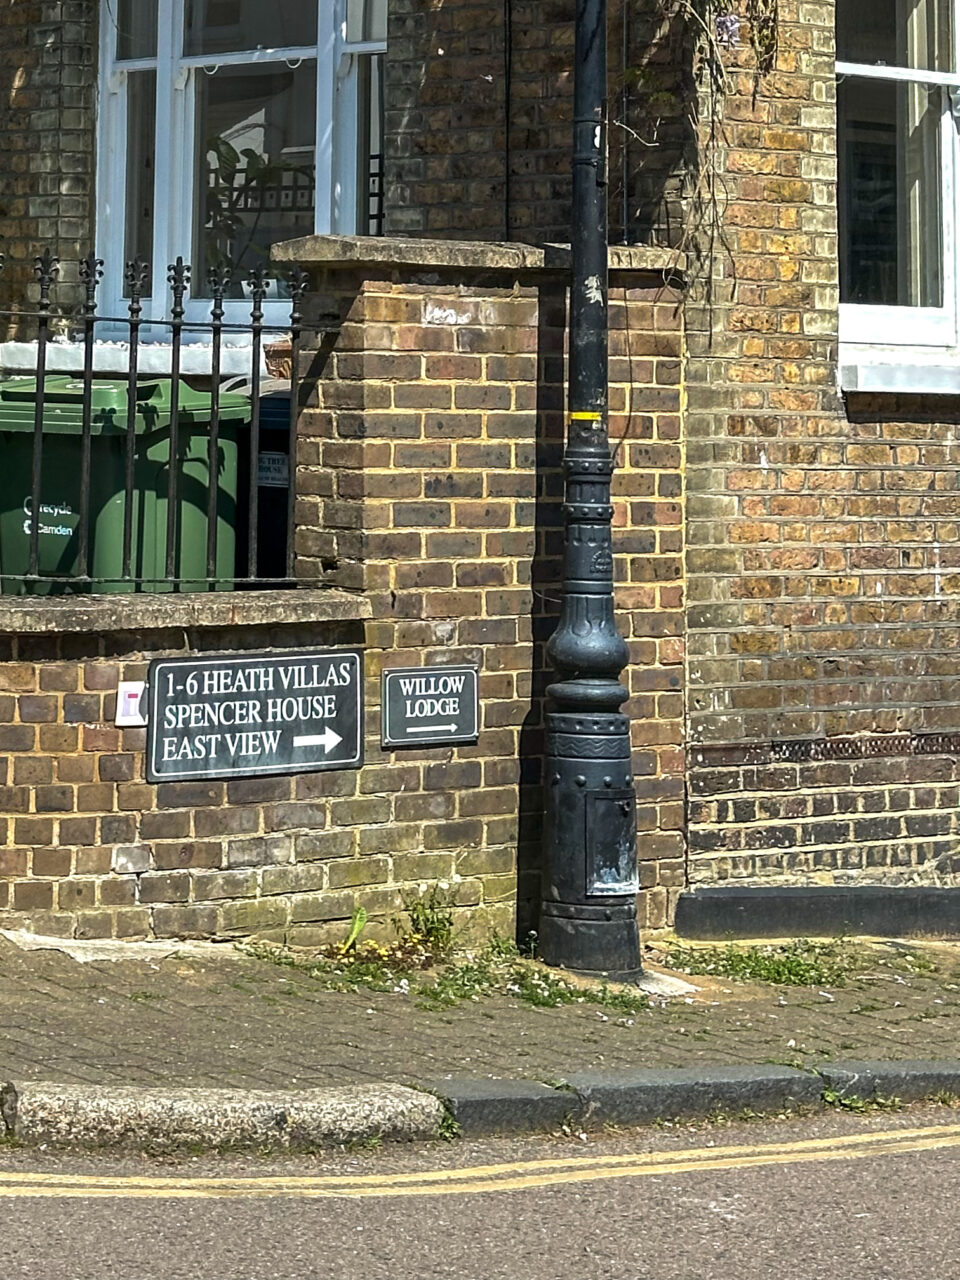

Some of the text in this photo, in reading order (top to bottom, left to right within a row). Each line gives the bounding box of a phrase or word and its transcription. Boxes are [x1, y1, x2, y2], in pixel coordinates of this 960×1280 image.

[37, 520, 73, 536] Camden
[166, 663, 351, 697] 1-6 HEATH VILLAS
[399, 675, 465, 696] WILLOW
[163, 695, 337, 729] SPENCER HOUSE
[405, 698, 460, 718] LODGE
[162, 729, 282, 761] EAST VIEW
